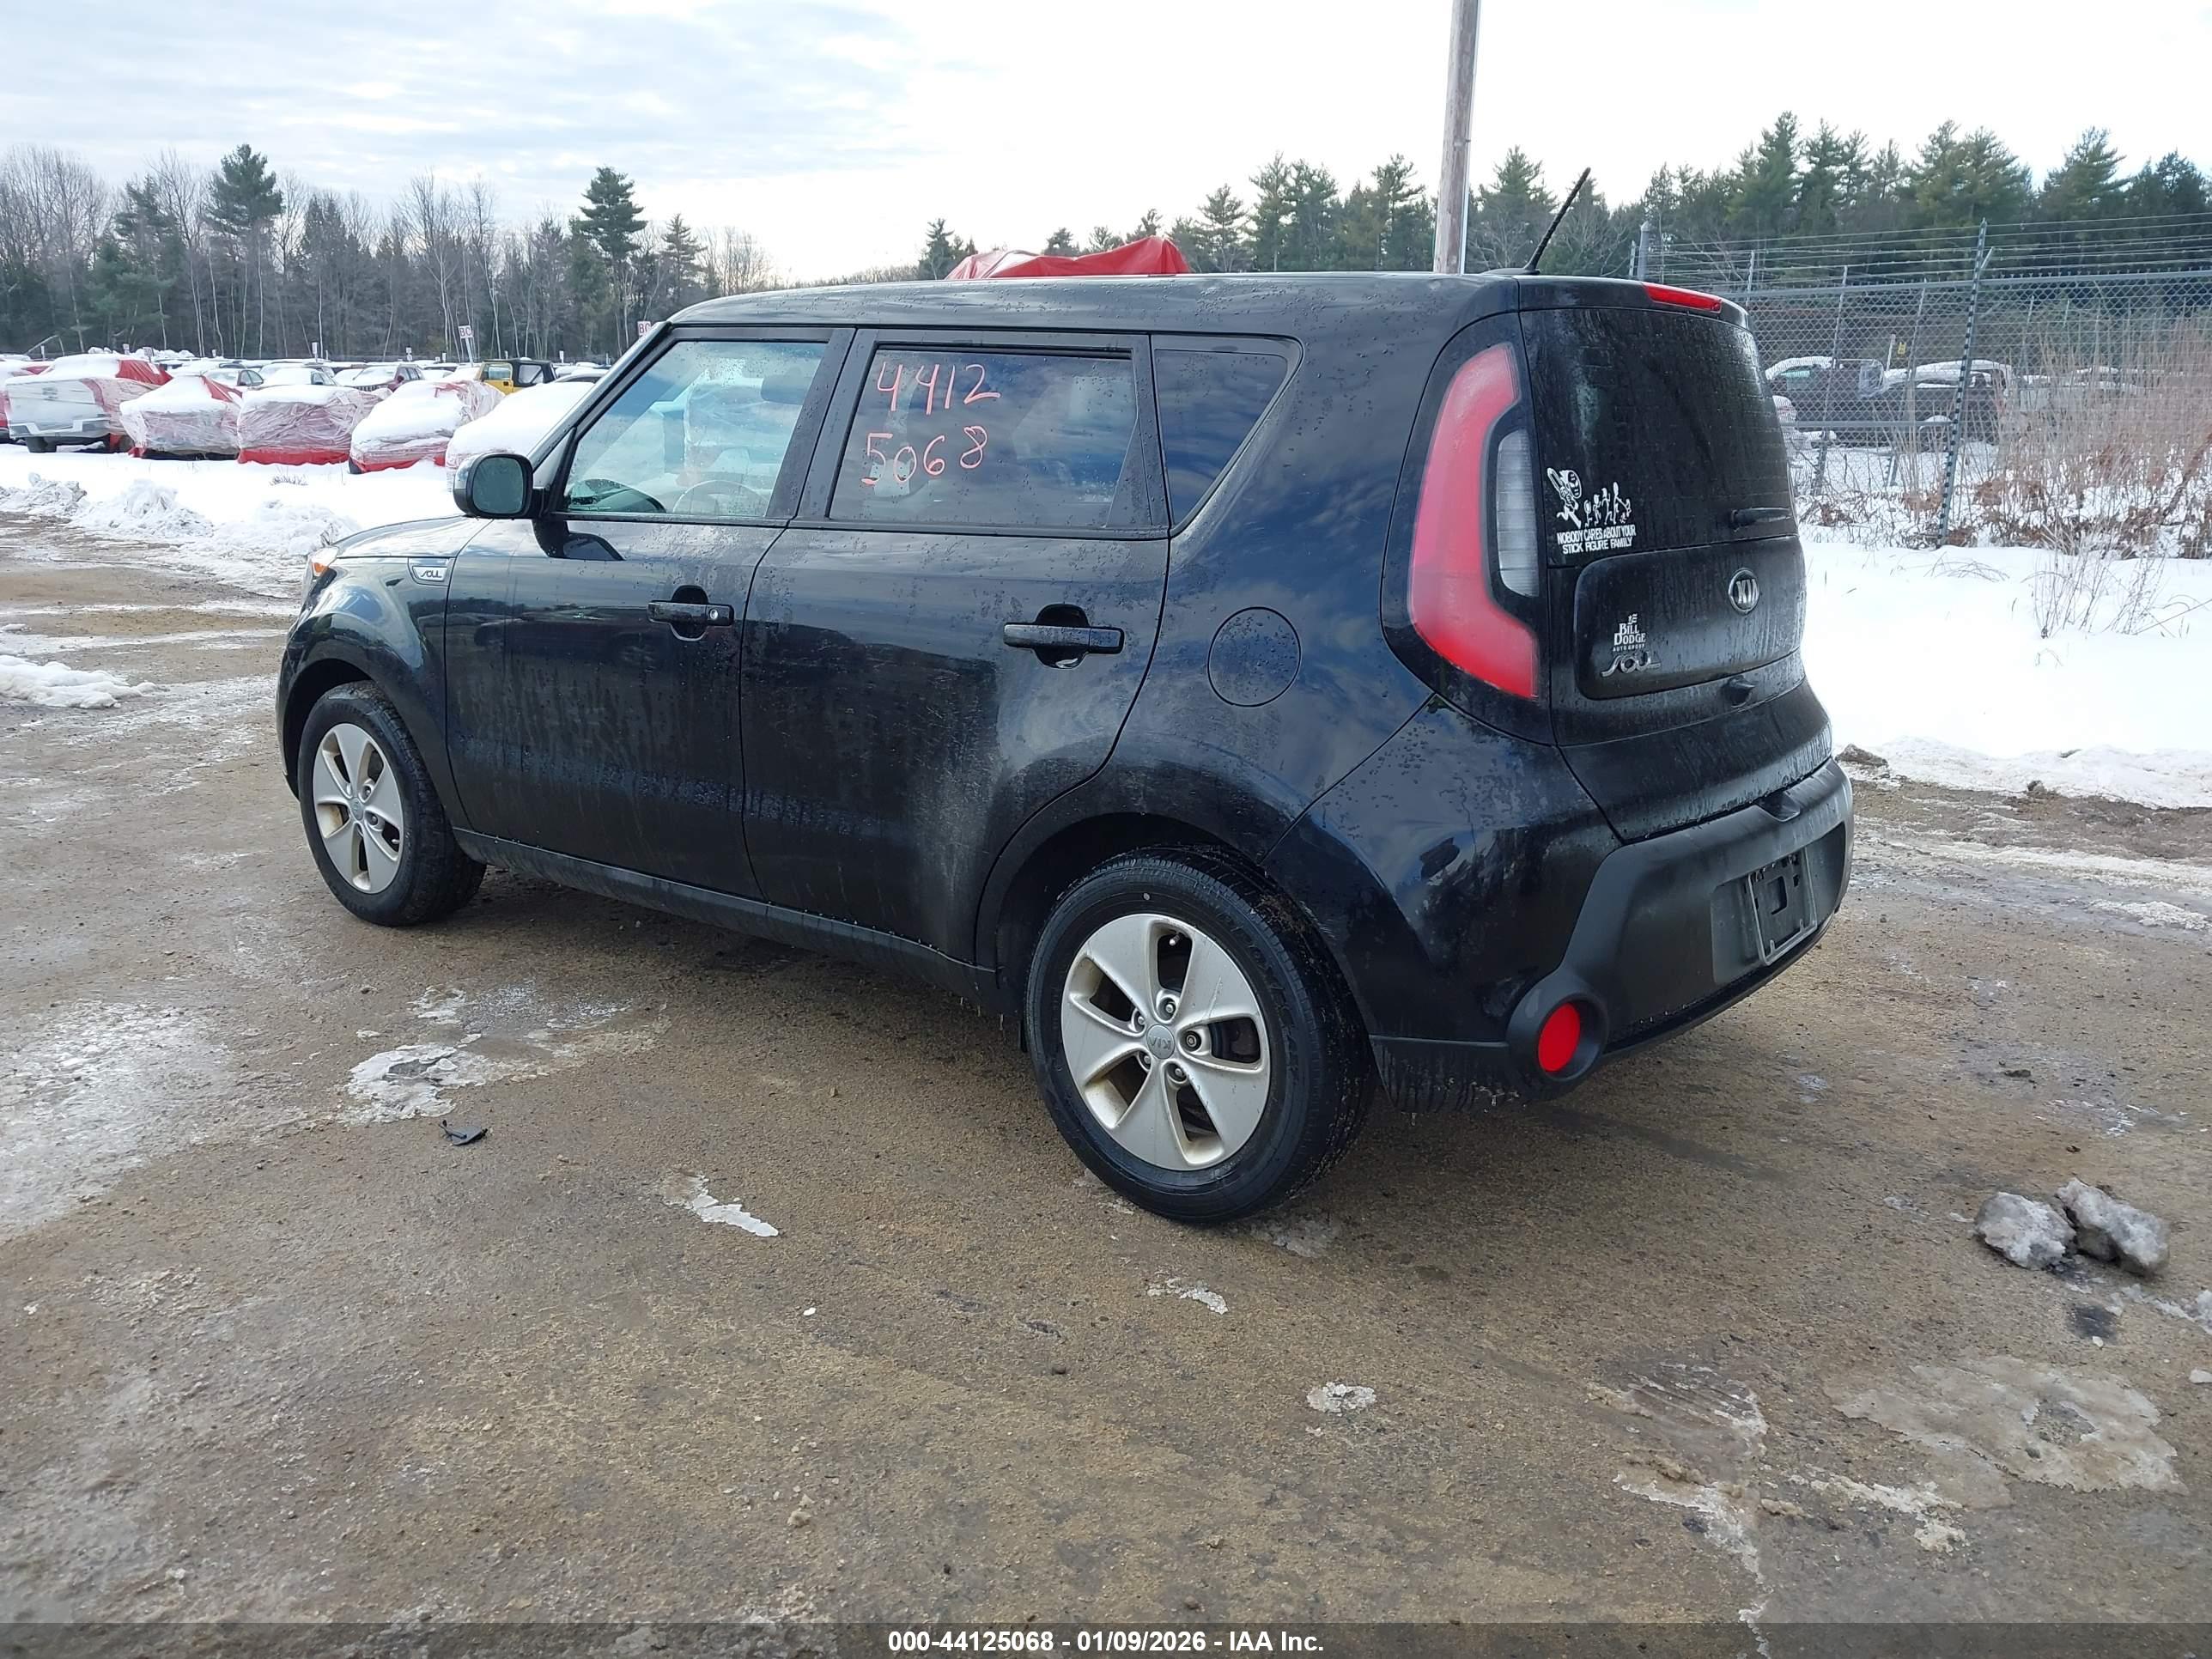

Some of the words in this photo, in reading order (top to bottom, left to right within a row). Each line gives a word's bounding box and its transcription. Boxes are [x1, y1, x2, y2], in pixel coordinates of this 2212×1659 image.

[876, 362, 1001, 416] 4412
[860, 425, 988, 483] 5068
[1557, 529, 1583, 545] NOBODY
[1583, 527, 1603, 542] CARES
[1603, 526, 1621, 539] ABOUT
[1620, 524, 1637, 538] YOUR
[1562, 542, 1583, 555] STICK
[1584, 539, 1609, 552] FIGURE
[1610, 537, 1633, 549] FAMILY
[1735, 578, 1759, 604] KIA
[1613, 632, 1647, 646] DODGE
[1619, 623, 1640, 635] BILL
